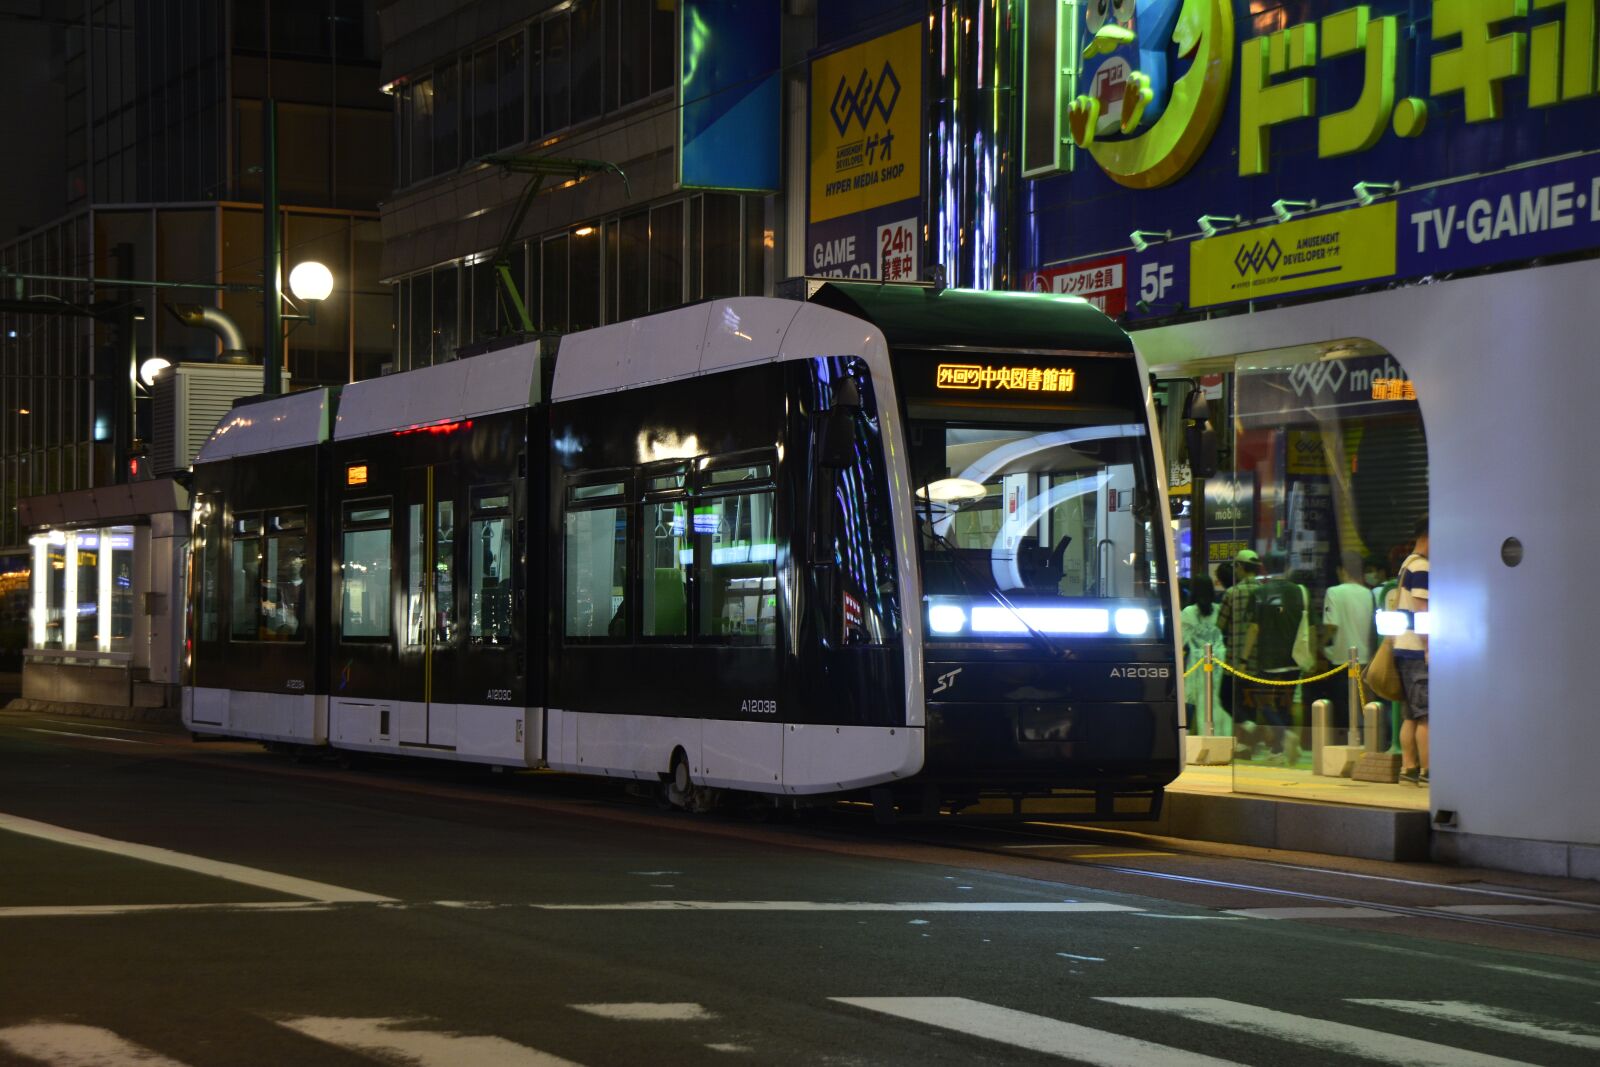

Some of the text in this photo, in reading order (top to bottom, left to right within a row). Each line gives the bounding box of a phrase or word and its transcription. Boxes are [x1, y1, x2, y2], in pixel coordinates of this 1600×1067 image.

[825, 163, 904, 197] HYPER MEDIA SHOP
[813, 235, 856, 269] GAME
[881, 225, 913, 256] 24h
[1296, 232, 1340, 250] AMUSEMENT
[881, 254, 913, 280] 営業中
[1283, 247, 1325, 266] DEVELOPER
[1061, 268, 1113, 294] レンタル会員
[1141, 262, 1173, 303] 5F
[981, 366, 1075, 392] 中央図書館前
[933, 667, 962, 694] ST
[1110, 667, 1169, 679] A1203B
[487, 689, 512, 700] A1203C
[741, 699, 777, 713] A1203B
